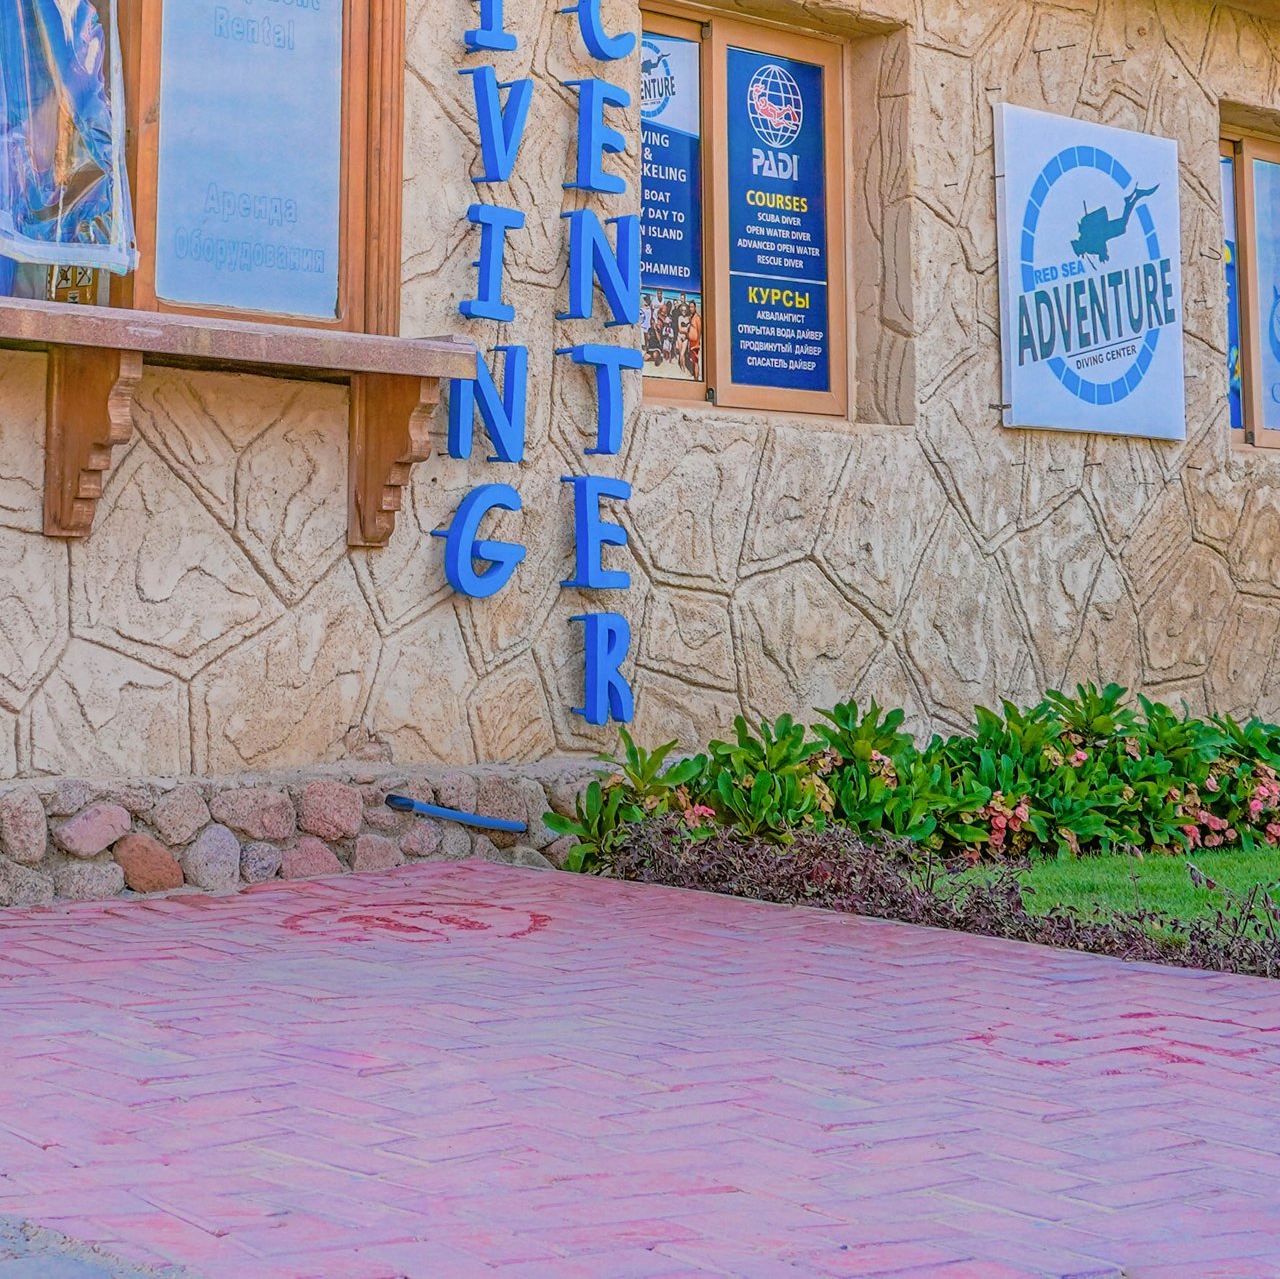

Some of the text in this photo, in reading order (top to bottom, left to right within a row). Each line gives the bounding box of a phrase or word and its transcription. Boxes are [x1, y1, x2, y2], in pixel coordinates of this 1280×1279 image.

[214, 7, 295, 49] Rental
[644, 147, 653, 160] &
[752, 148, 799, 181] PADI
[204, 182, 298, 226] Аренда
[644, 189, 671, 203] BOAT
[746, 190, 808, 213] COURSES
[648, 207, 669, 221] DAY
[671, 211, 685, 223] TO
[757, 212, 802, 226] SCUBA DIVER
[648, 226, 684, 241] ISLAND
[746, 225, 811, 242] OPEN WATER DIVER
[174, 226, 324, 273] Оборудования
[645, 244, 653, 255] &
[737, 239, 820, 257] ADVANCED OPEN WATER
[757, 255, 804, 269] RESCUE DIVER
[1034, 260, 1086, 285] RED SEA
[748, 286, 810, 309] КУРСЫ
[756, 311, 805, 324] АКВАЛАНГИСТ
[1018, 258, 1176, 367] ADVENTURE
[737, 324, 824, 341] ОТКРЫТАЯ ВОДА ДАЙВЕР
[740, 339, 822, 356] ПРОДВИНУТЫЙ ДАЙВЕР
[747, 356, 817, 371] СПАСАТЕЛЬ ДАЙВЕР
[1076, 344, 1137, 370] DIVING CENTER
